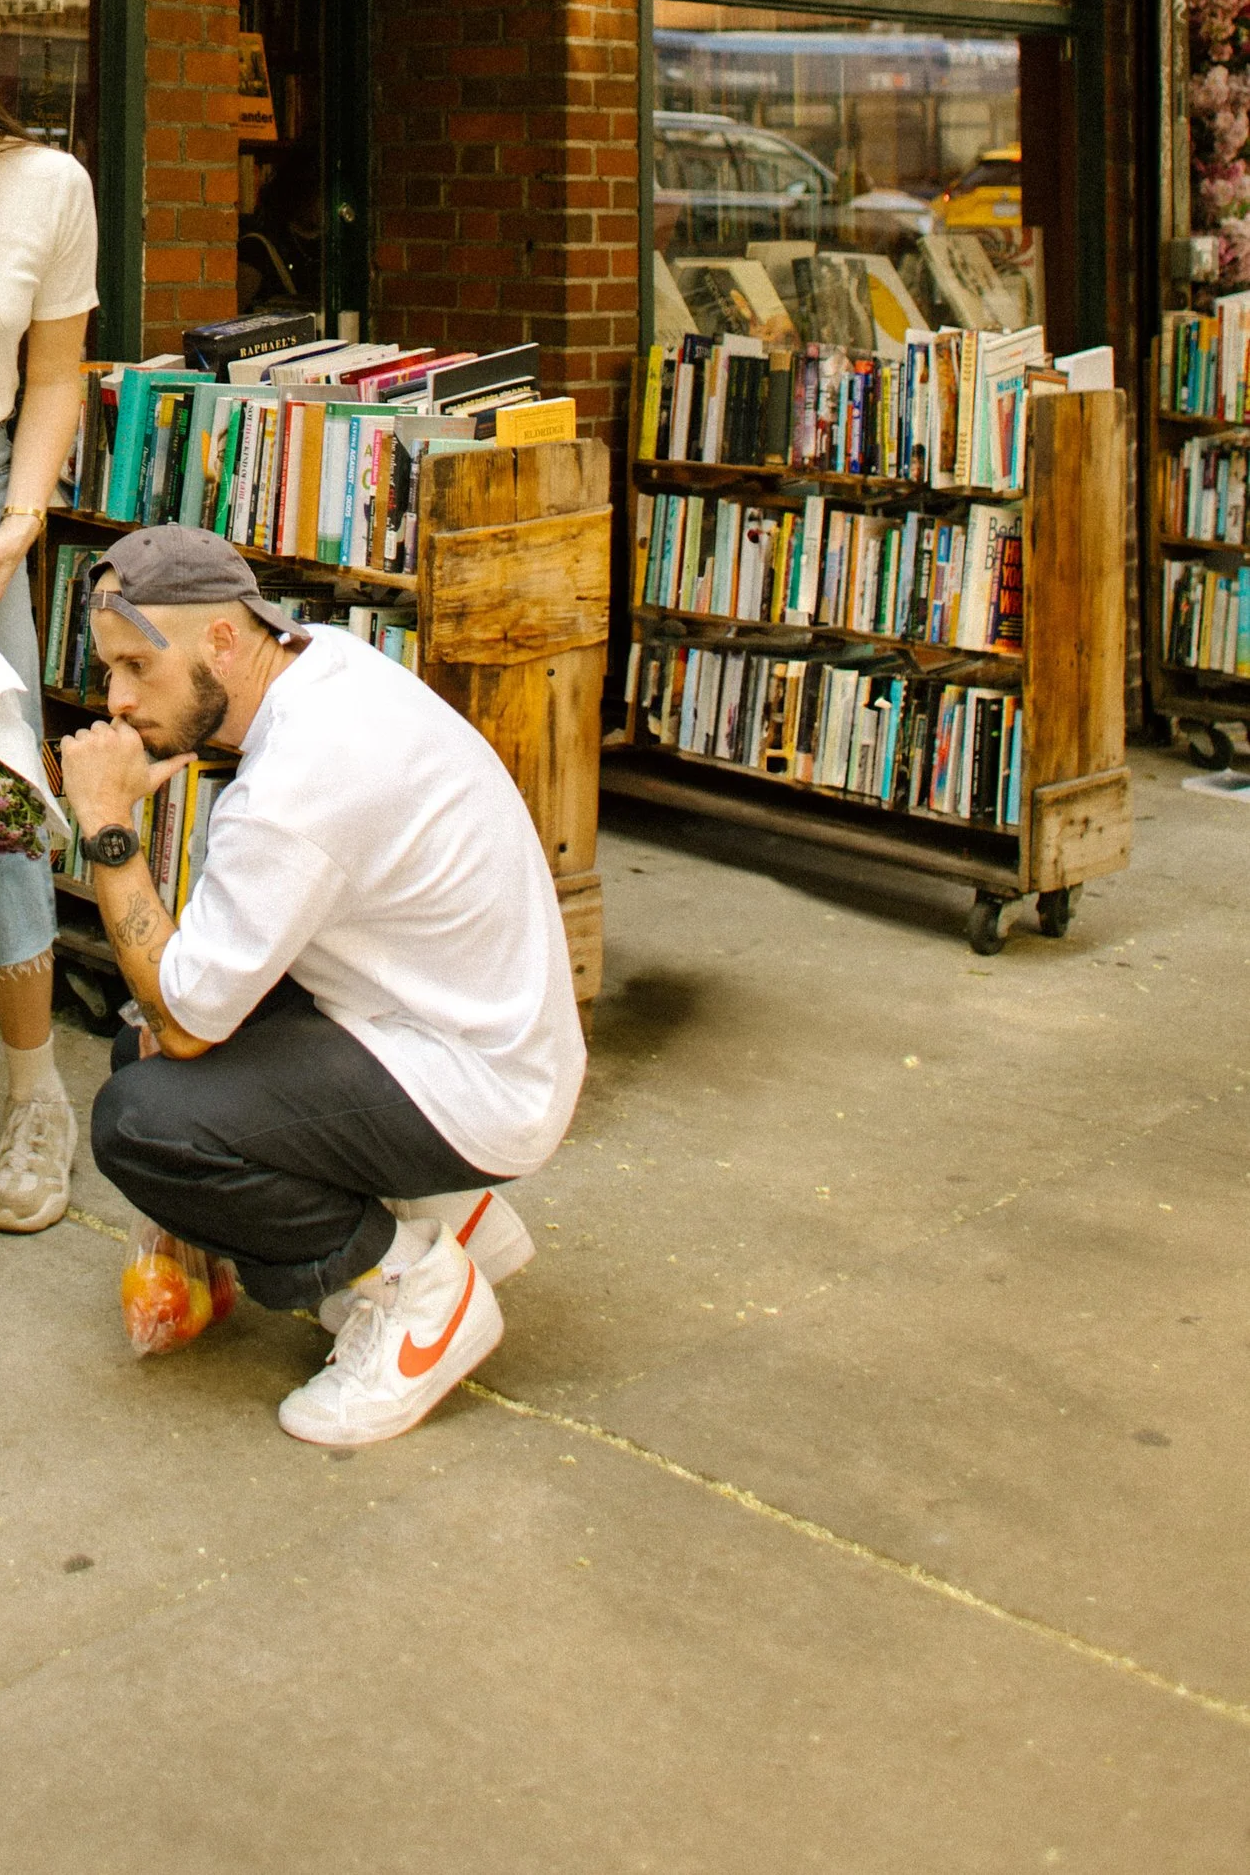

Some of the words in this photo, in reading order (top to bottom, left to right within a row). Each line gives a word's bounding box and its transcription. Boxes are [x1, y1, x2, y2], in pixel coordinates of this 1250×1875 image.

[239, 334, 297, 358] RAPHAEL'S
[244, 422, 253, 445] THAT
[241, 445, 250, 468] KIND
[348, 447, 357, 484] AGAINST
[344, 494, 353, 518] ODDS
